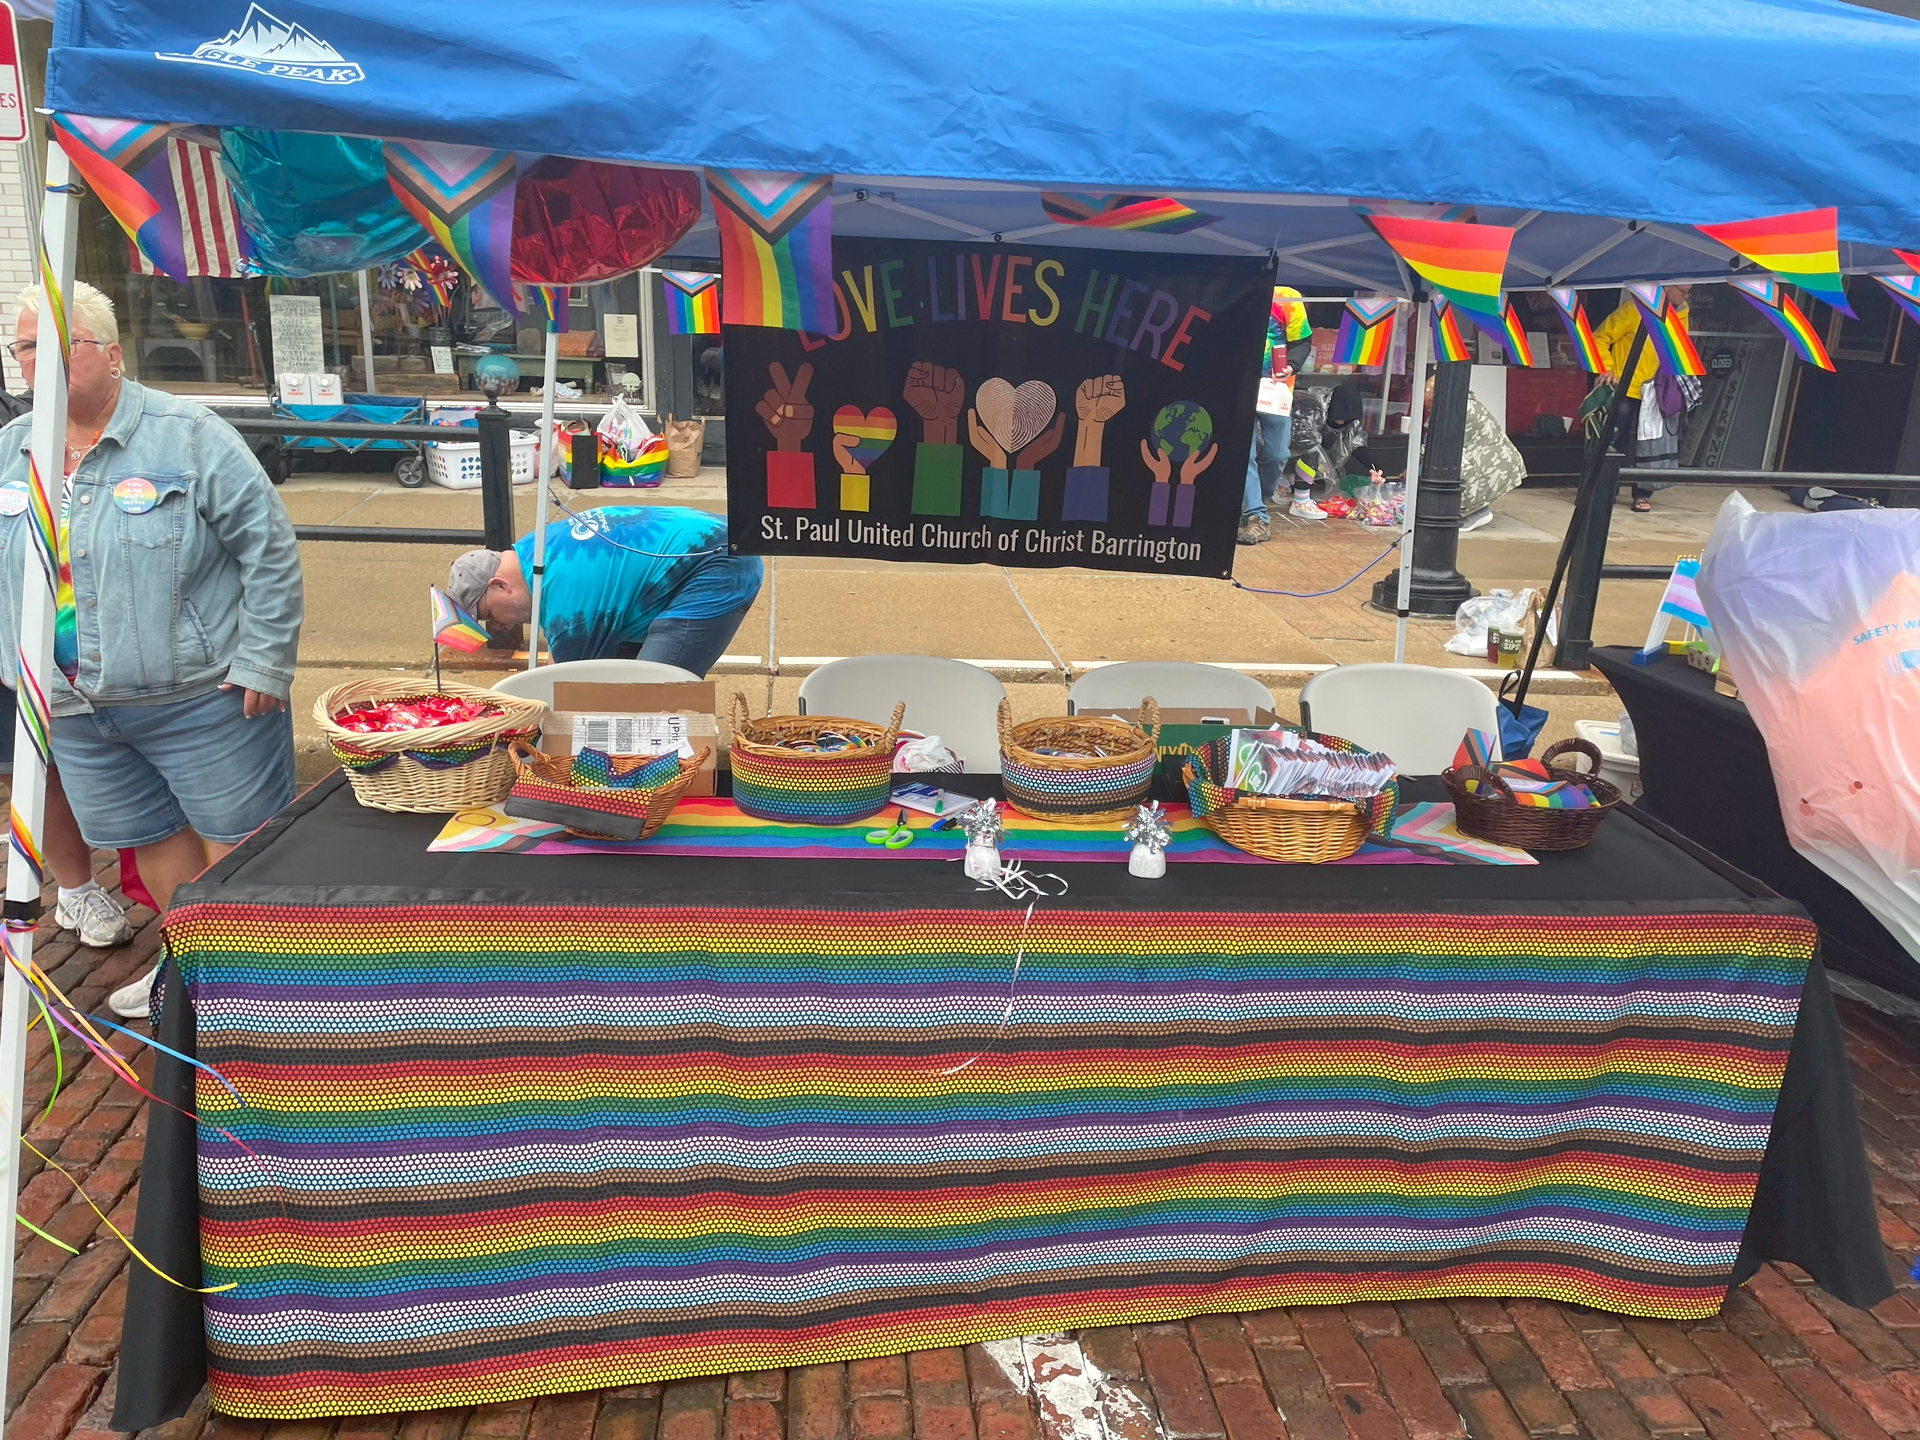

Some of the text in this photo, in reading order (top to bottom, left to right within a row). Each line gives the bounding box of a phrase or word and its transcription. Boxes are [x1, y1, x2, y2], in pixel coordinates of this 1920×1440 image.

[267, 63, 353, 82] PEAK
[928, 253, 1066, 327] LIVES
[1074, 268, 1213, 373] HERE
[760, 514, 1202, 564] St. Paul United Church of Christ Barrington
[1852, 622, 1899, 646] SAFETY
[1503, 643, 1520, 651] SIPS
